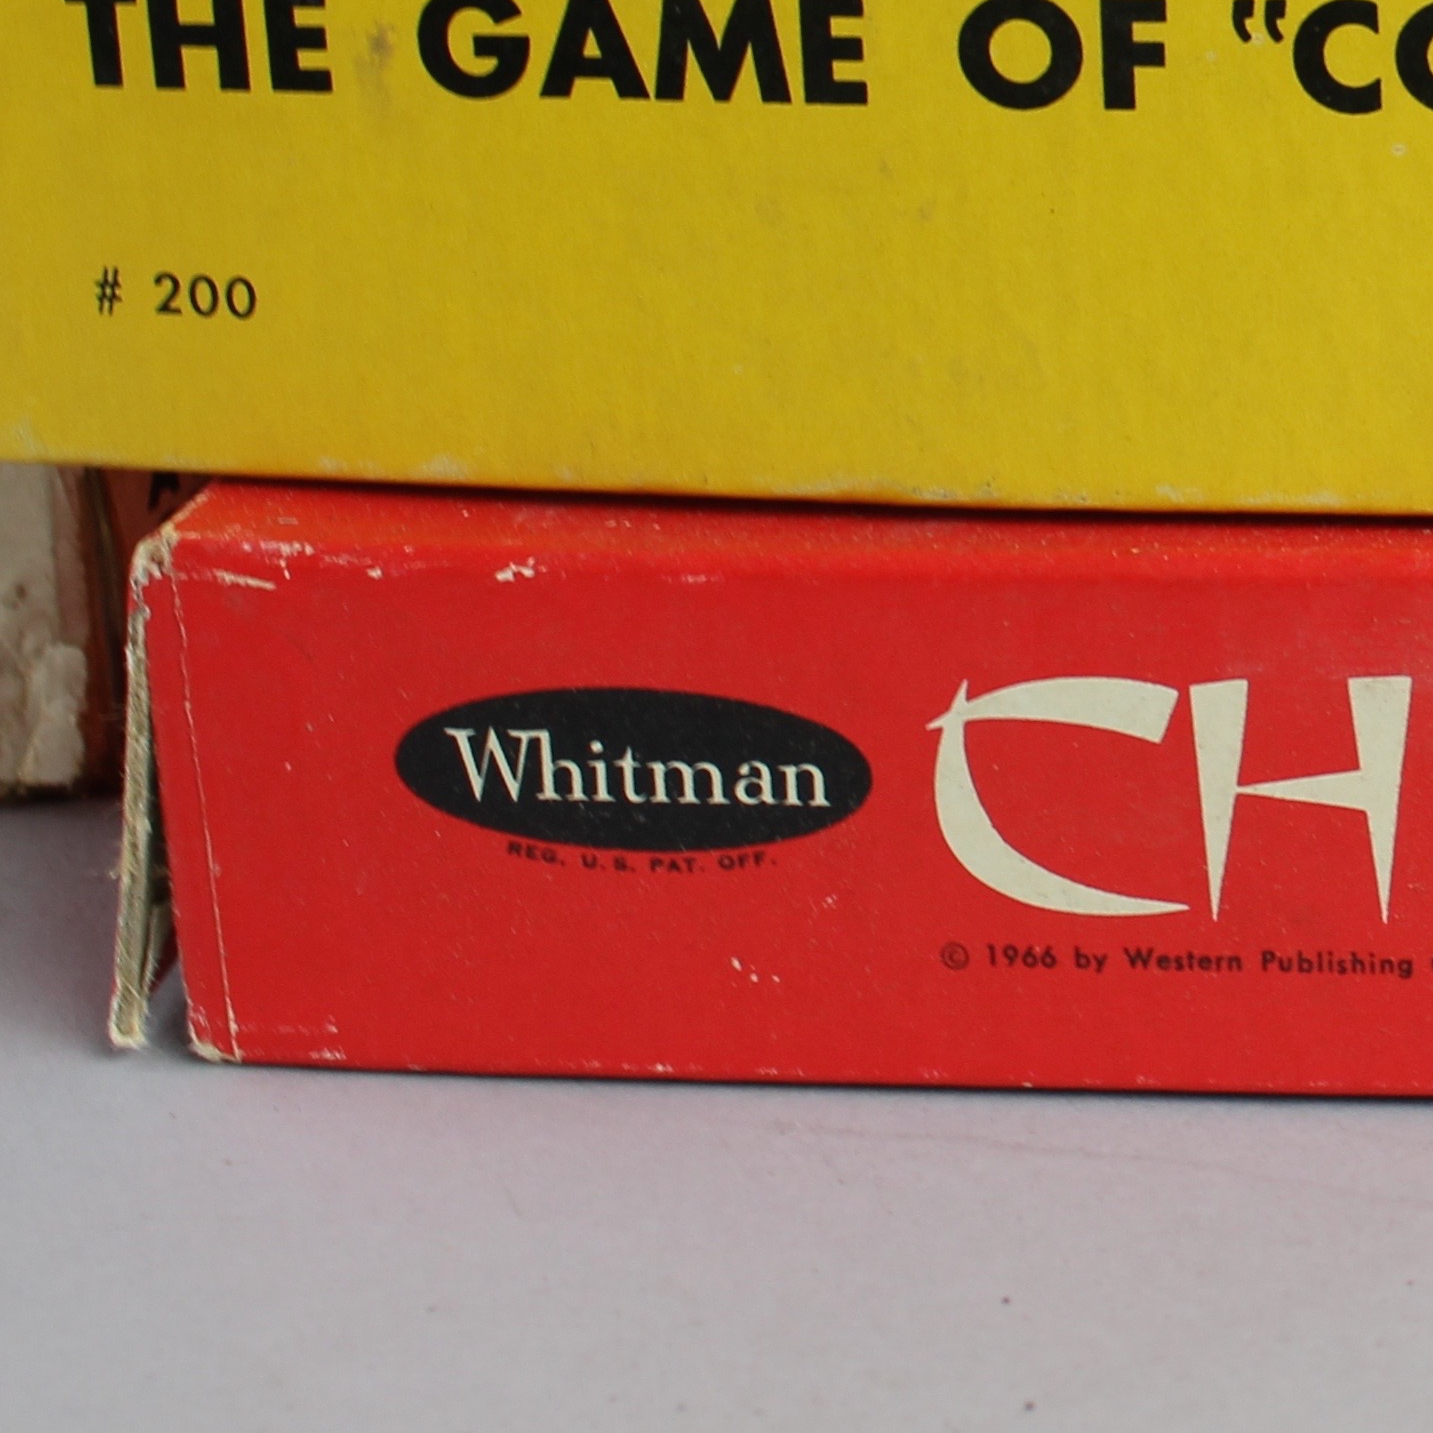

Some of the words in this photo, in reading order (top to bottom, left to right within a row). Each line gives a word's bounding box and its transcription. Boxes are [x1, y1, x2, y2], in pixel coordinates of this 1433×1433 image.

[153, 271, 257, 321] 200
[444, 726, 831, 808] Whitman
[986, 943, 1058, 970] 1966
[1073, 945, 1107, 974] by
[1123, 946, 1244, 972] Western
[1260, 950, 1415, 980] Publishing
